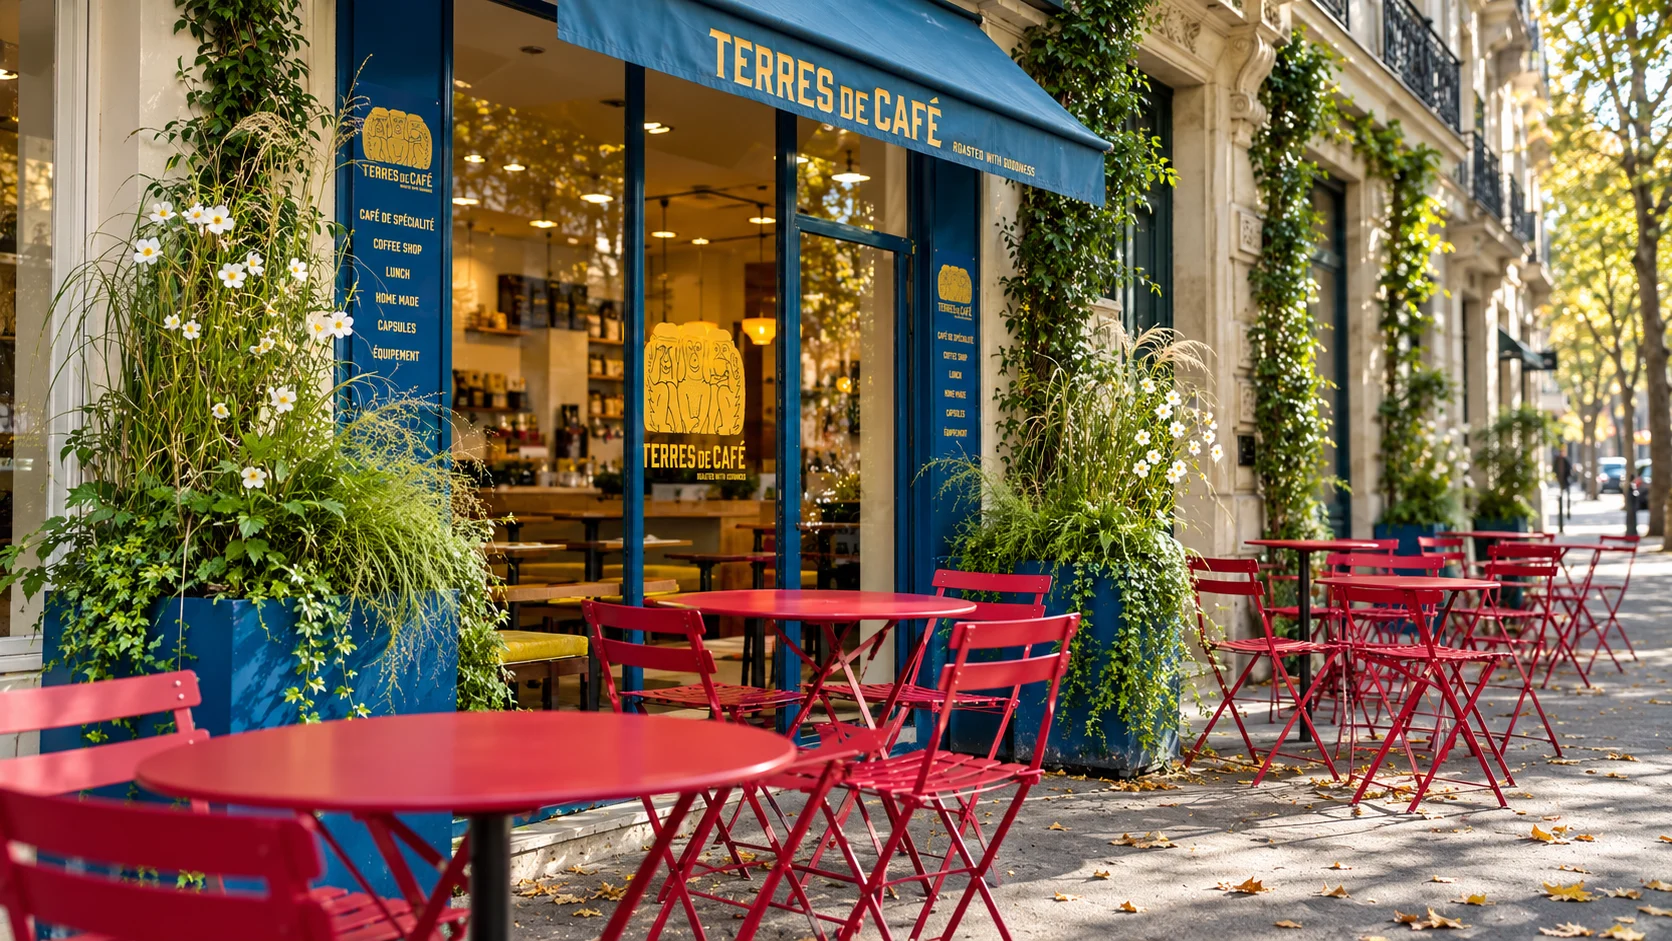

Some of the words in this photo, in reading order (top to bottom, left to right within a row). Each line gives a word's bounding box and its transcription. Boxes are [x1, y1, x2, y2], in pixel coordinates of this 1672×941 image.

[709, 27, 834, 114] TERRES
[840, 85, 869, 126] DE
[874, 86, 942, 149] CAFÉ
[952, 141, 984, 161] ROASTED
[362, 163, 399, 182] TERRES
[399, 172, 410, 184] DE
[410, 172, 433, 188] CAFÉ
[359, 208, 380, 222] CAFÉ
[381, 212, 392, 224] DE
[393, 213, 435, 232] SPÉCIALITÉ
[373, 237, 401, 253] COFFEE
[402, 242, 423, 255] SHOP
[385, 266, 411, 280] LUNCH
[375, 292, 397, 305] HOME
[398, 295, 420, 308] MADE
[377, 319, 417, 335] CAPSULES
[373, 344, 420, 362] ÉQUIPEMENT
[643, 443, 696, 469] TERRES
[697, 450, 711, 469] DE
[713, 440, 746, 470] CAFÉ
